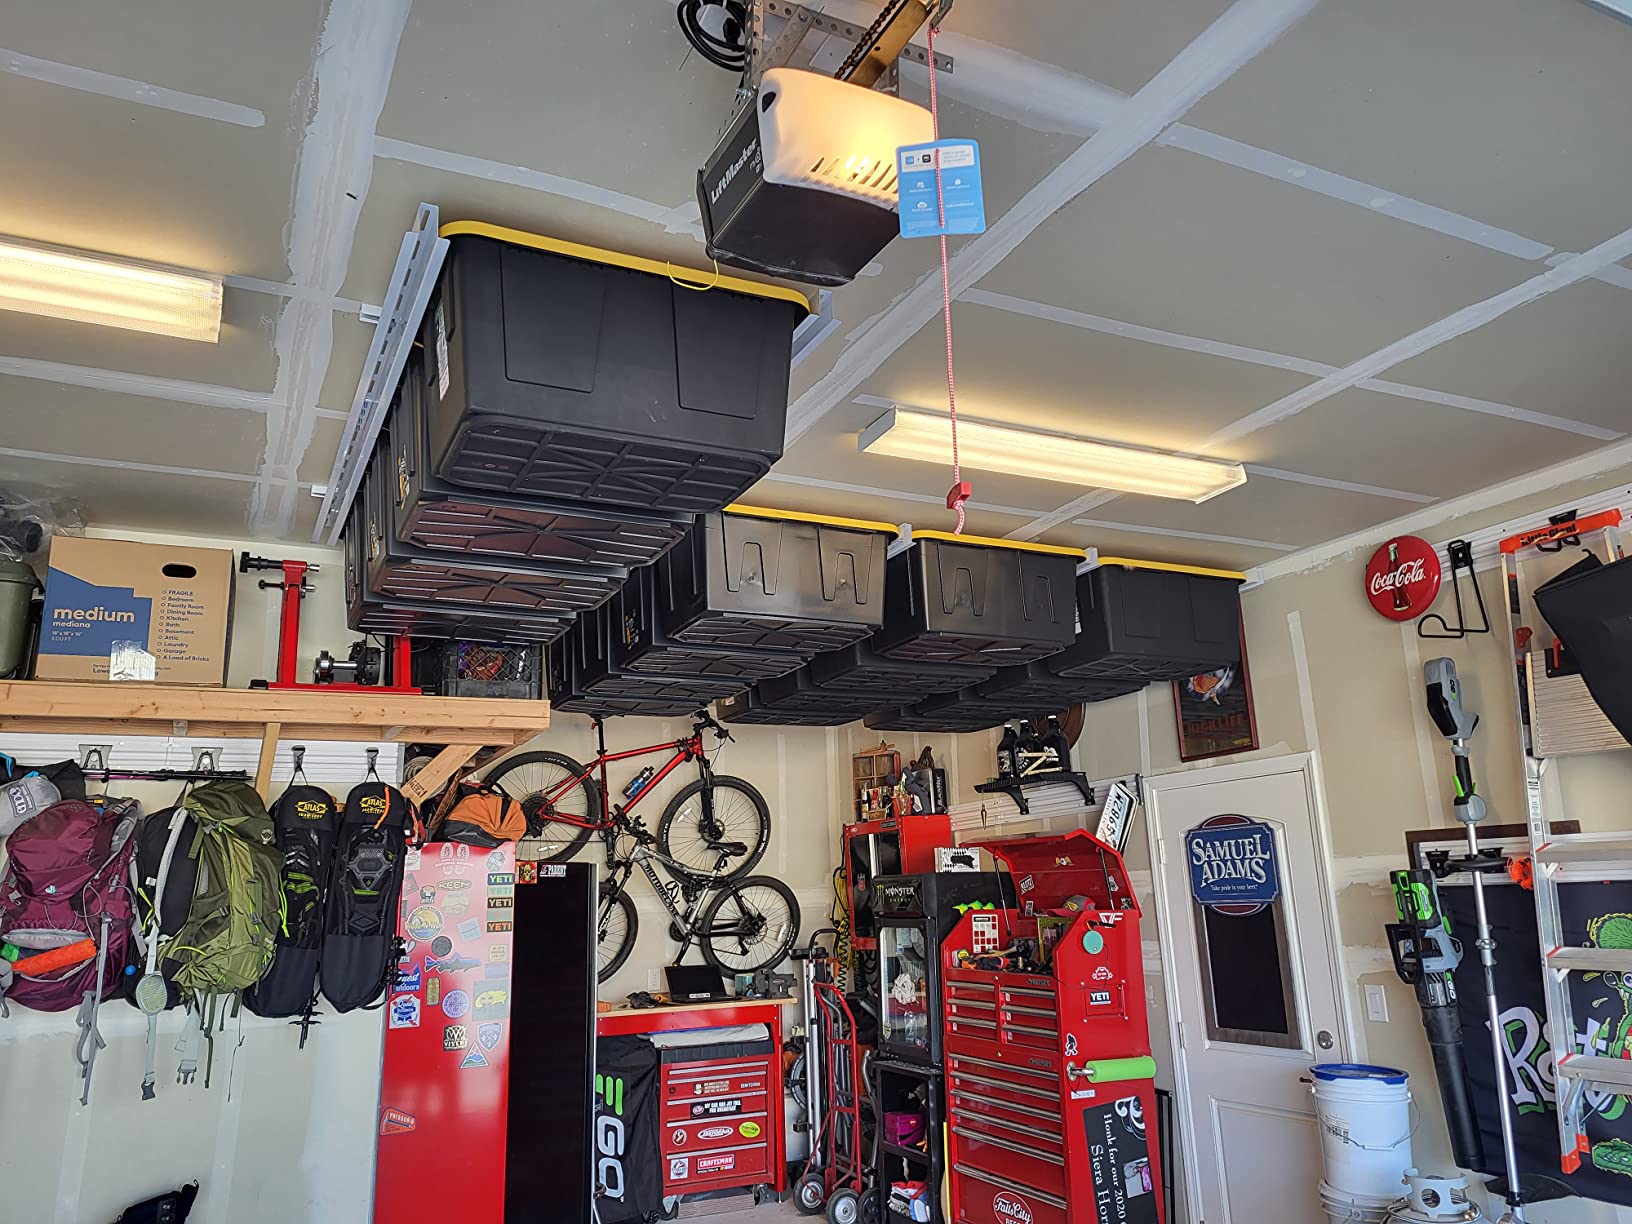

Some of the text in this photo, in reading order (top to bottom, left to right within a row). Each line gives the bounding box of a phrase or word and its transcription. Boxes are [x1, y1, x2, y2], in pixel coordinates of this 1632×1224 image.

[711, 138, 757, 204] LiftMaster
[1520, 523, 1578, 547] Little Giant
[1371, 557, 1425, 595] Coca-Cola
[53, 606, 135, 623] medium
[52, 621, 91, 629] mediana
[303, 803, 320, 812] ATLAS
[367, 799, 383, 807] ATLAS
[1191, 834, 1270, 866] SAMUEL
[489, 874, 513, 883] YETI
[1200, 858, 1267, 888] ADAMS
[438, 881, 471, 890] KEEN
[490, 886, 513, 895] YETI
[643, 863, 680, 917] MOTOBECANE
[885, 886, 915, 897] MONSTER
[489, 898, 512, 907] YETI
[488, 922, 512, 931] YETI
[1090, 992, 1110, 1001] YETI
[595, 1073, 625, 1198] EGO
[1103, 1113, 1118, 1146] Honk
[699, 1156, 734, 1169] CRAFTSMAN
[1108, 1147, 1119, 1165] for
[1090, 1144, 1114, 1224] Siera Hor
[1111, 1167, 1120, 1187] our
[994, 1197, 1032, 1224] Falls City
[1114, 1189, 1127, 1220] 2020
